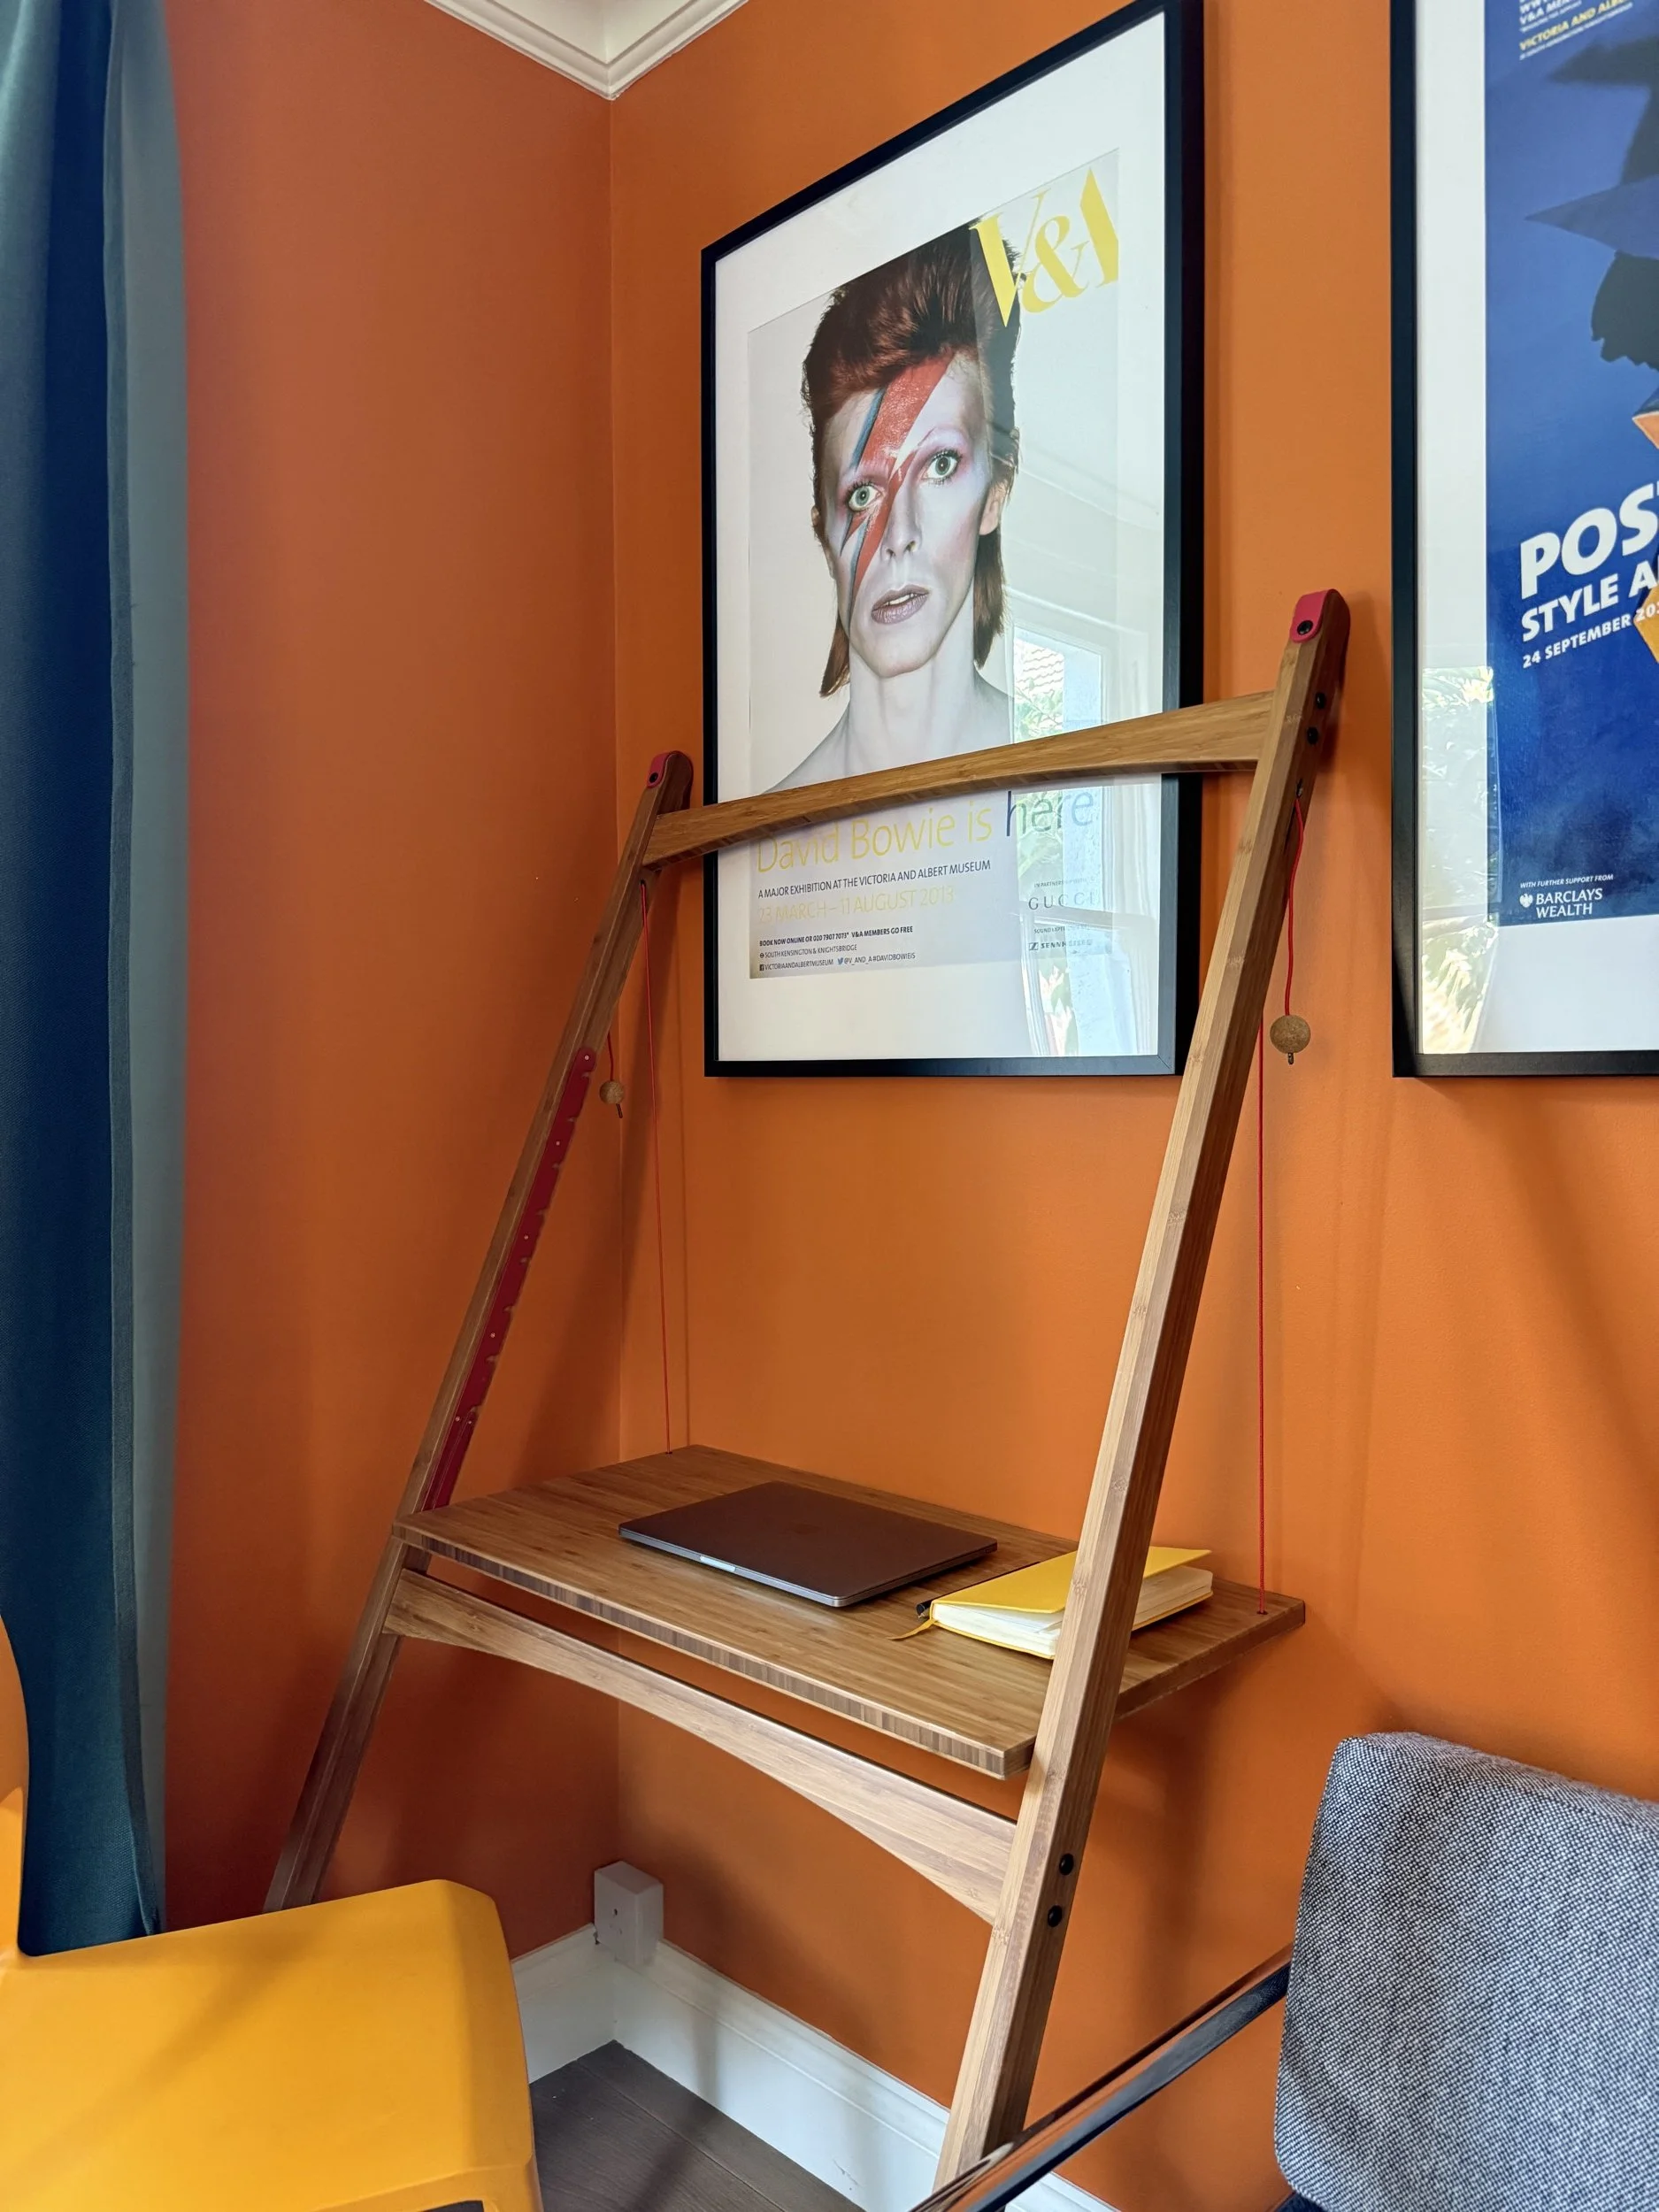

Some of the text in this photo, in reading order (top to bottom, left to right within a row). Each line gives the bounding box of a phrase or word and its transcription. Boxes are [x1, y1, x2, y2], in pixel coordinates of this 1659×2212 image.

[1519, 20, 1570, 50] VICTORIA
[1571, 7, 1596, 27] AND
[969, 165, 1119, 327] V&A
[1520, 481, 1659, 600] POS
[1521, 557, 1659, 642] STYLE A
[1523, 650, 1541, 669] 24
[1545, 613, 1632, 660] SEPTEMBER
[757, 790, 1094, 873] David Bowie is here
[757, 859, 992, 899] A MAJOR EXHIBITION AT THE VICTORIA AND ALBERT MUSEUM
[1536, 887, 1603, 905] BARCLAYS
[1537, 879, 1564, 887] FURTHER
[1565, 876, 1594, 885] SUPPORT
[775, 899, 827, 922] MARCH
[853, 888, 917, 914] AUGUST
[1028, 892, 1094, 910] GUCCI
[1536, 902, 1593, 918] WEALTH
[780, 948, 812, 957] KENSINGTON
[818, 944, 857, 954] KNIGHTSBRIDGE
[864, 927, 890, 937] MEMBERS
